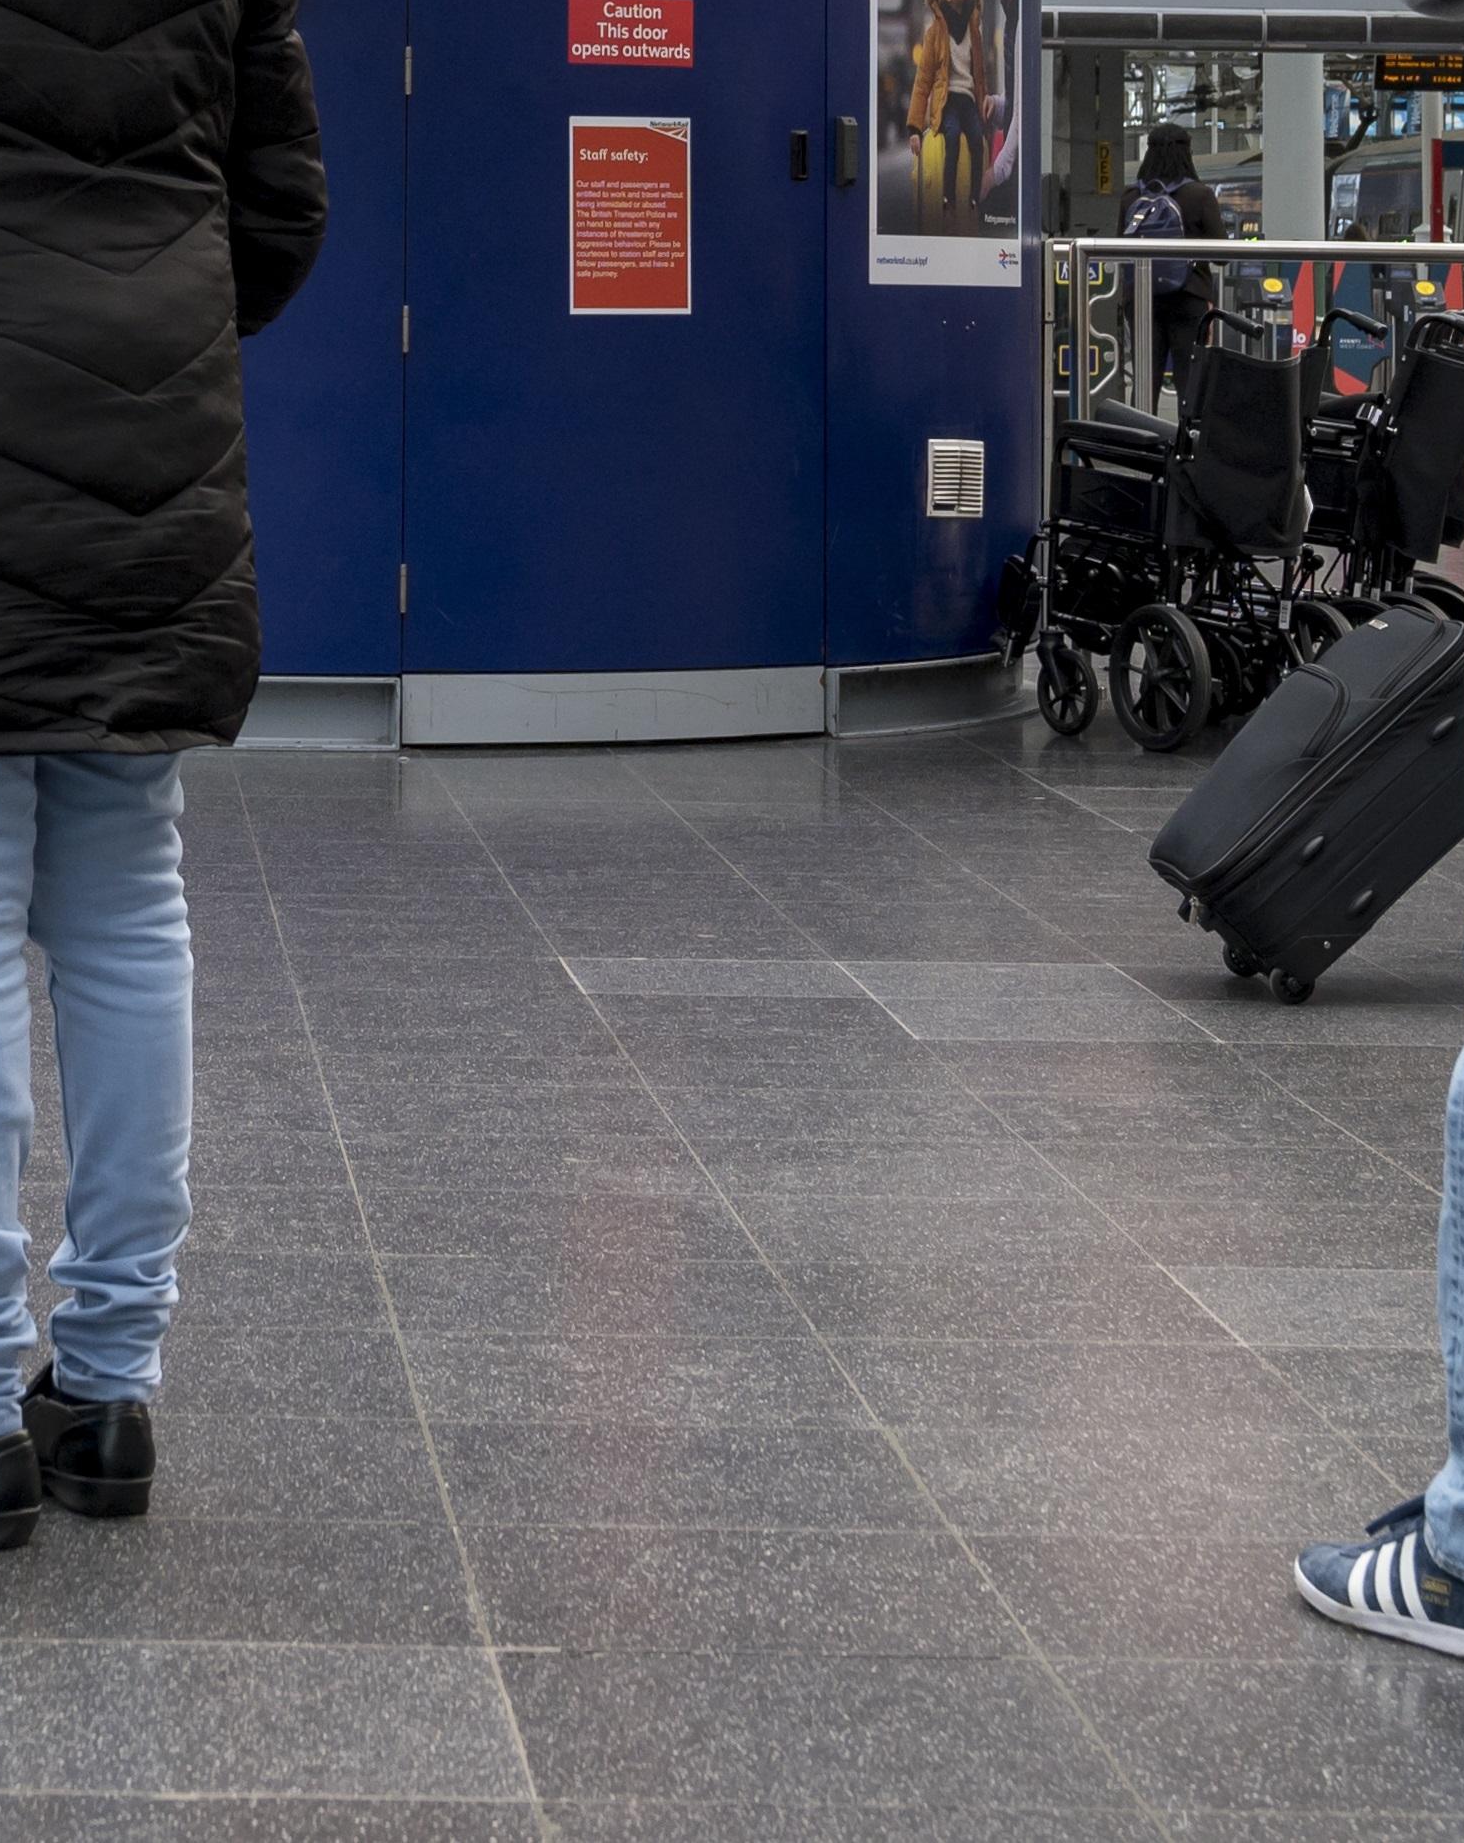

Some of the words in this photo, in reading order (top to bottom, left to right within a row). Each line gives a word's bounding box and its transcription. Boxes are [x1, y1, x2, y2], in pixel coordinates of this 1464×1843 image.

[603, 1, 662, 20] Caution
[596, 22, 630, 39] This
[632, 24, 668, 40] door
[572, 42, 618, 58] opens
[622, 42, 690, 60] outwards
[580, 148, 608, 162] Staff
[610, 149, 649, 164] safety:
